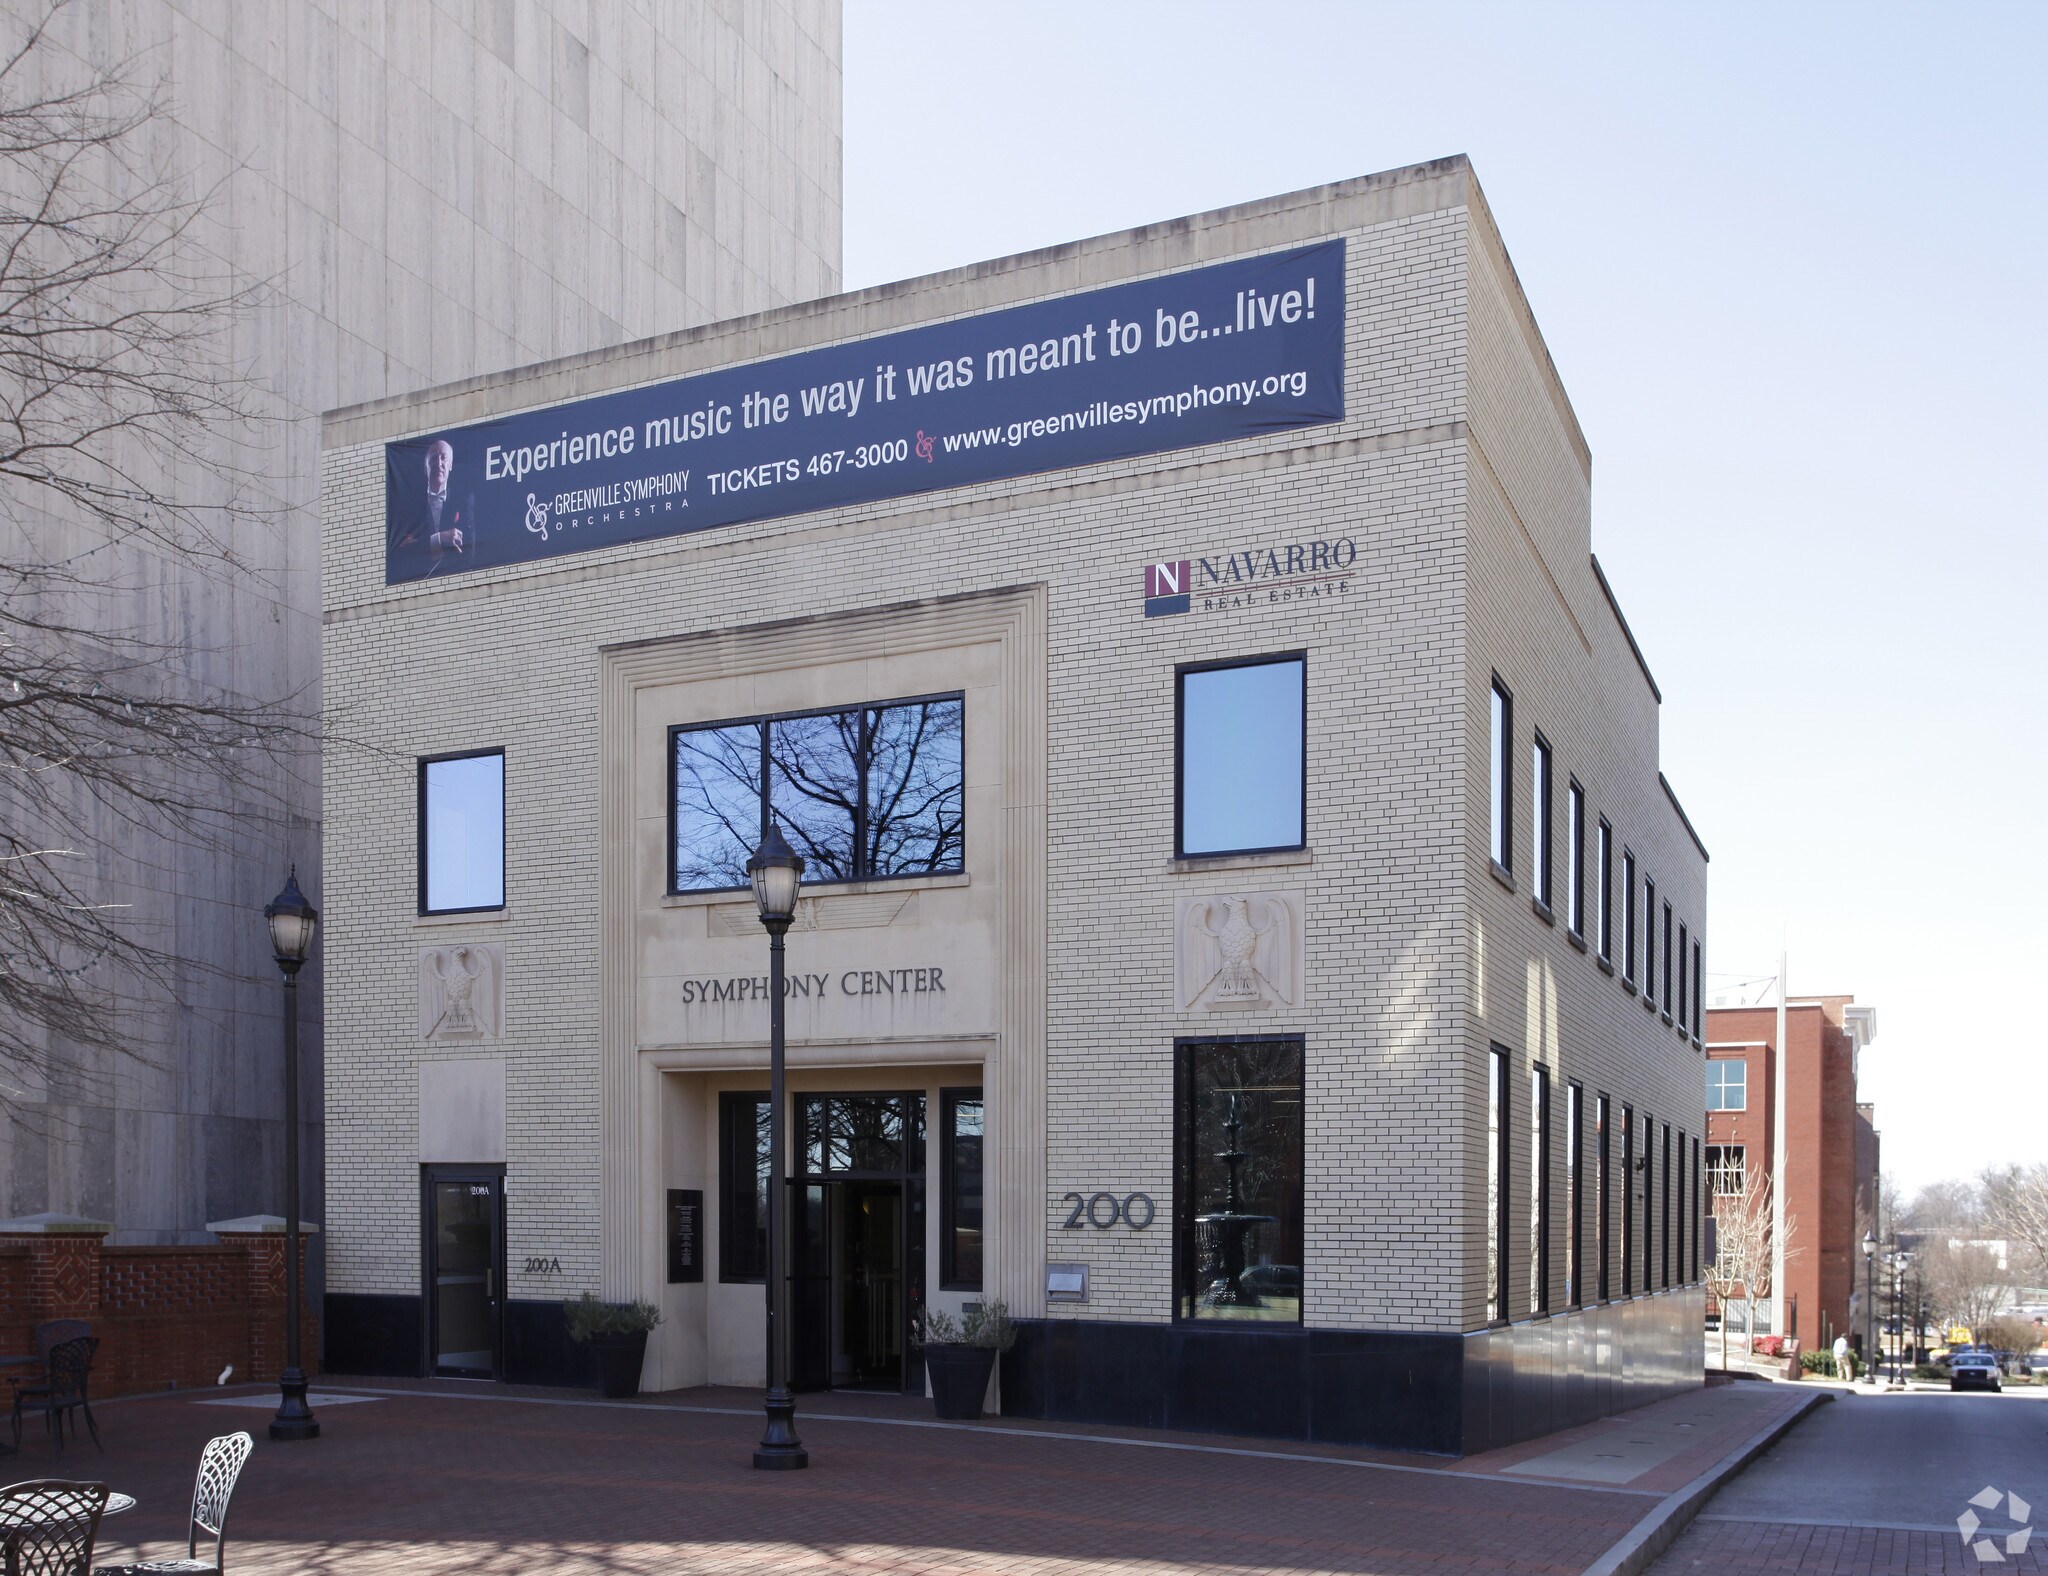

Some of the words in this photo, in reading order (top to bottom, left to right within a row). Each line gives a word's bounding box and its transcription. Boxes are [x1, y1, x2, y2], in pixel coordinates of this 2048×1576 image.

[485, 426, 634, 482] Experience
[645, 400, 732, 449] music
[742, 391, 789, 428] the
[801, 378, 864, 417] way
[876, 364, 897, 403] it
[907, 356, 974, 396] was
[986, 324, 1097, 381] meant
[1107, 318, 1142, 357] to
[942, 371, 1307, 453] www.greenvillesymphony.org
[707, 459, 800, 496] TICKETS
[806, 439, 908, 477] 467-3000
[555, 483, 621, 515] GREENVILLE
[623, 470, 690, 503] SYMPHONY
[555, 499, 690, 532] ORCHESTRA
[1155, 561, 1179, 595] N
[1197, 538, 1356, 587] NAVARRO
[1204, 593, 1256, 611] REAL
[1269, 581, 1349, 602] ESTATE
[841, 967, 946, 996] CENTER
[1063, 1191, 1155, 1230] 200
[525, 1257, 562, 1273] 200A
